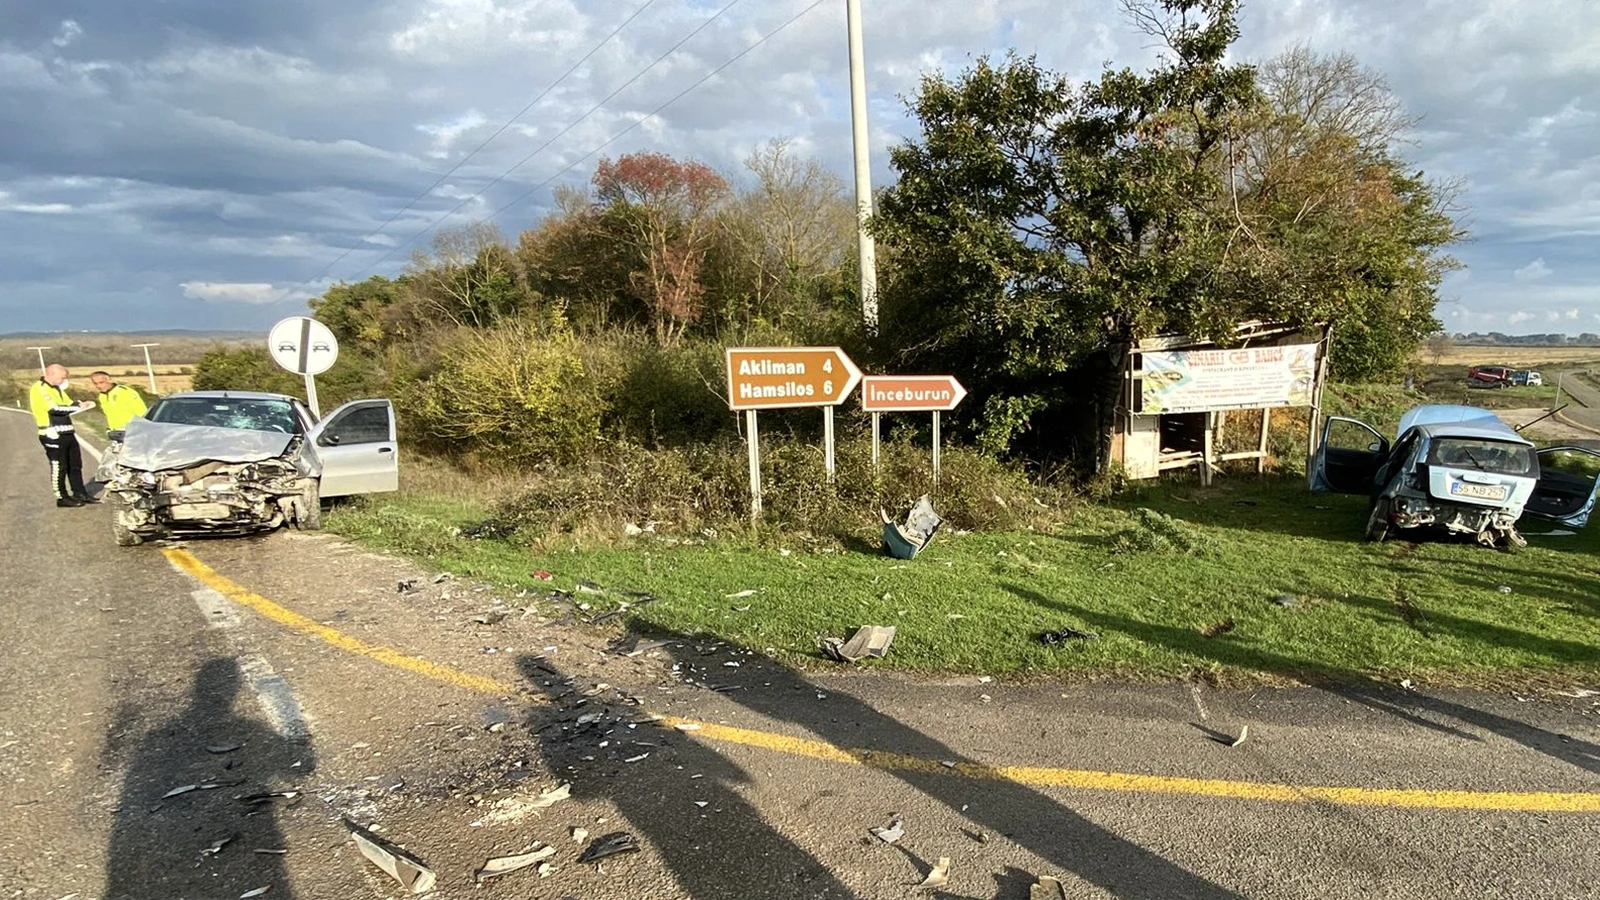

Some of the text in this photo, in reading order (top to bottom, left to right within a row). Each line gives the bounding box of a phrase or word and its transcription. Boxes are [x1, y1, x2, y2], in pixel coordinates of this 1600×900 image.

[739, 358, 833, 375] Akliman 4
[740, 379, 833, 398] Hamsilos 6
[870, 384, 950, 401] İnceburun
[1472, 487, 1486, 495] NB
